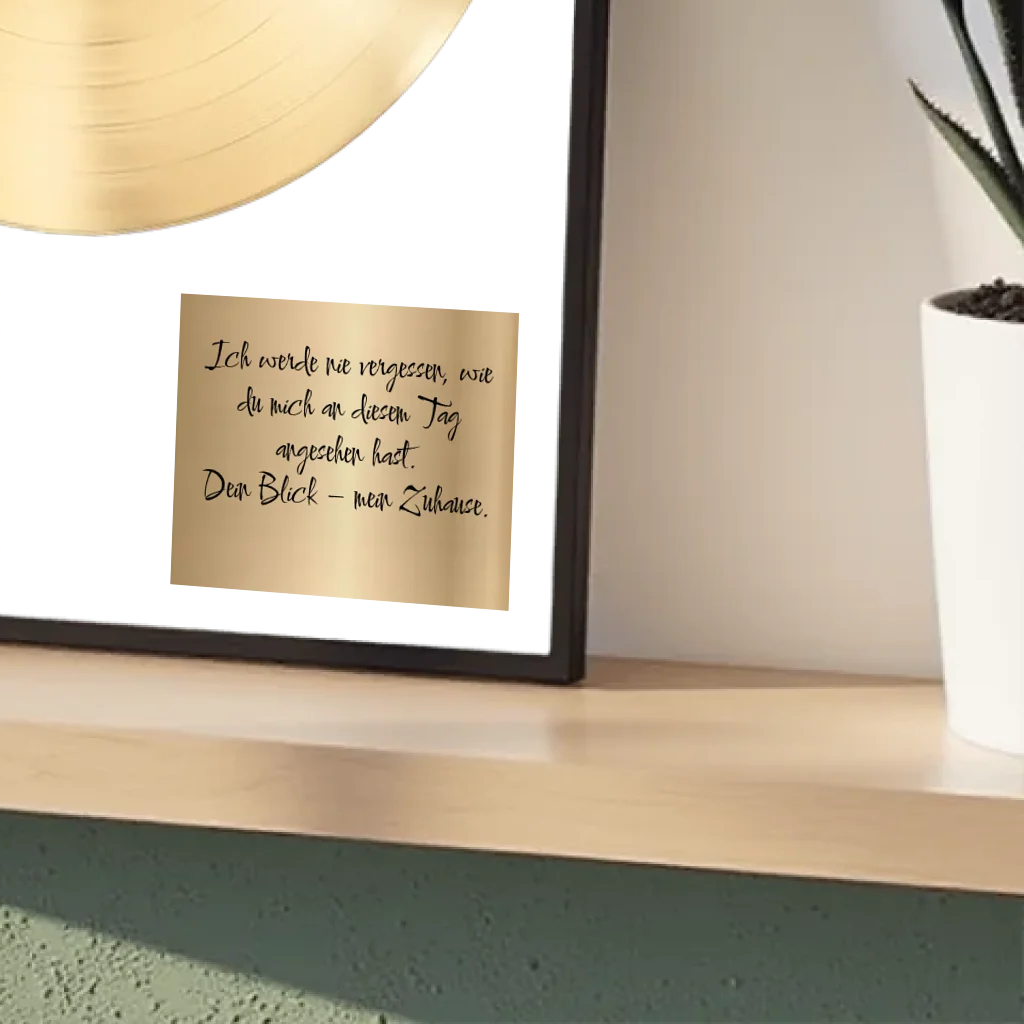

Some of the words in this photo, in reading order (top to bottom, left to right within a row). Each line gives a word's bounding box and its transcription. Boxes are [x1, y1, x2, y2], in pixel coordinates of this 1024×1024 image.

[204, 339, 252, 371] Ich
[259, 345, 319, 377] werde
[325, 355, 352, 376] nie
[359, 359, 447, 392] vergessen,
[459, 364, 494, 384] wie
[237, 386, 264, 417] du
[270, 388, 315, 418] mich
[321, 401, 346, 420] an
[351, 393, 411, 425] diesem
[417, 394, 462, 441] Tag
[275, 435, 365, 475] angesehen
[371, 437, 420, 469] hast.
[202, 468, 252, 501] Dein
[258, 471, 319, 505] Blick
[353, 488, 393, 510] mein
[398, 484, 488, 517] Zuhause.
